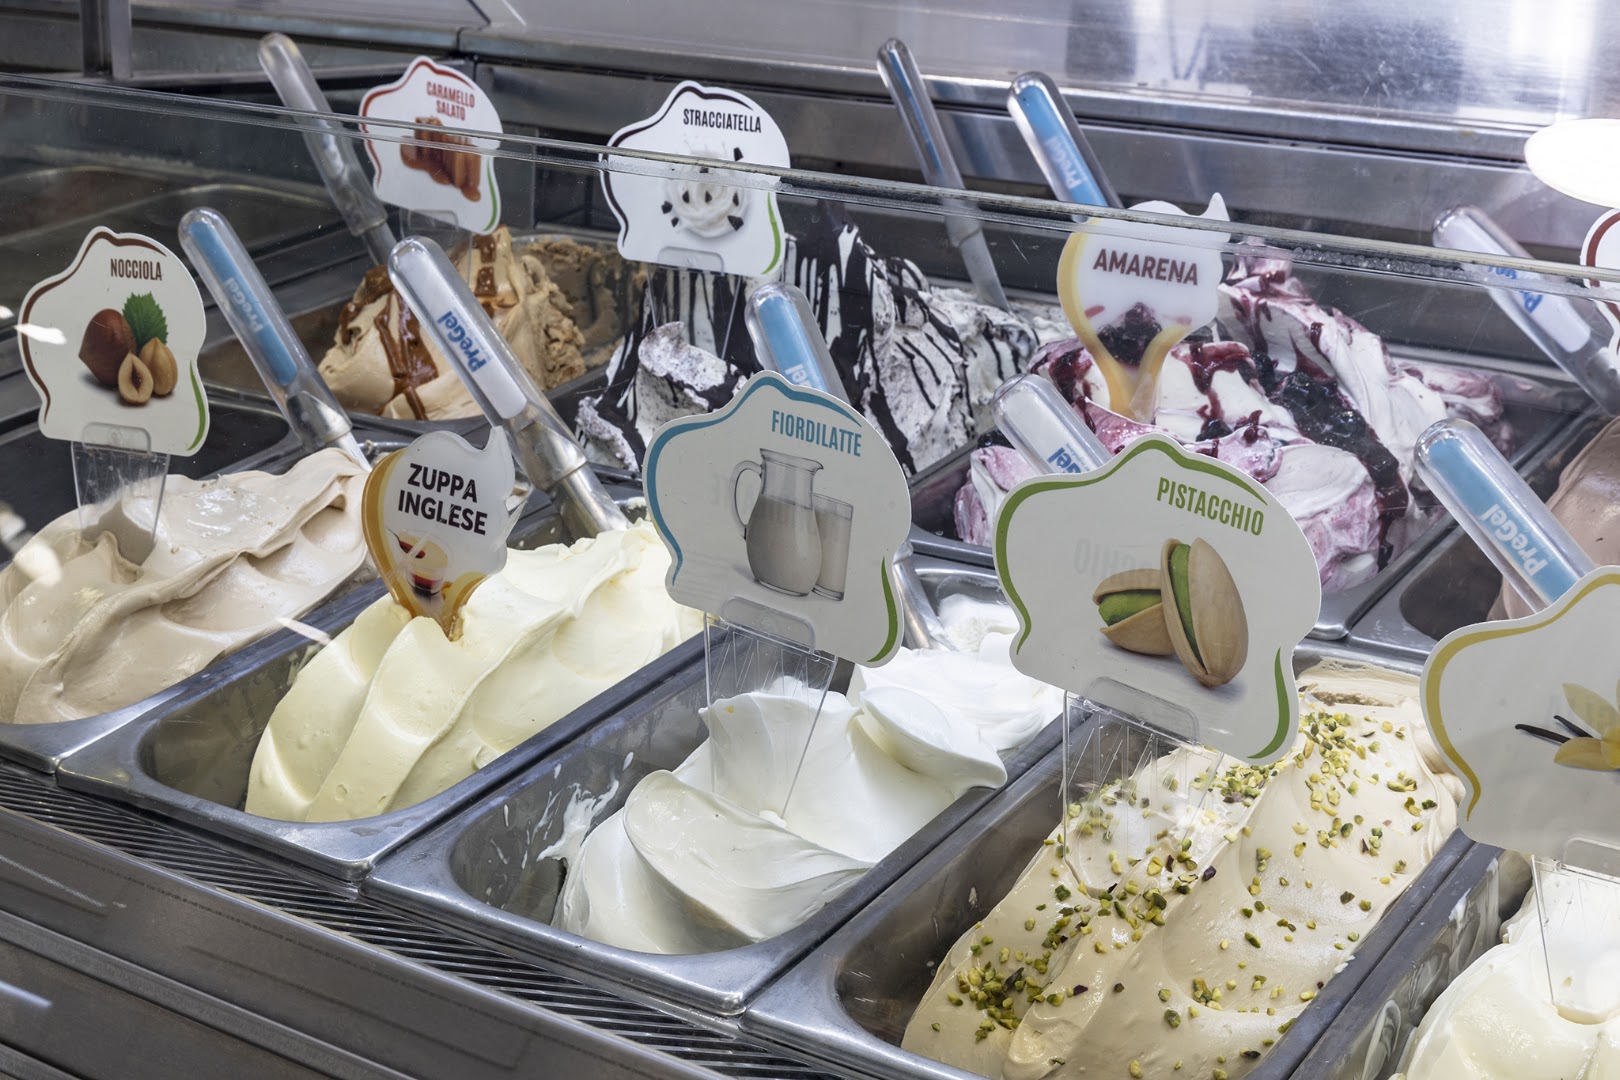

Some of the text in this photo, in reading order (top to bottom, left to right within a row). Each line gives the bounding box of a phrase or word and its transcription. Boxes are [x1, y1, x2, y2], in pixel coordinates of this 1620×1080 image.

[426, 81, 475, 108] CARAMELLO
[436, 99, 466, 121] SALATO
[683, 108, 762, 133] STRACCIATELLA
[110, 258, 162, 281] NOCCIOLA
[1092, 248, 1198, 286] AMARENA
[437, 310, 487, 373] PreGel
[771, 409, 862, 458] FIORDILATTE
[407, 462, 478, 504] ZUPPA
[398, 489, 488, 536] INGLESE
[1156, 476, 1264, 536] PISTACCHIO
[1478, 503, 1549, 577] PreGel
